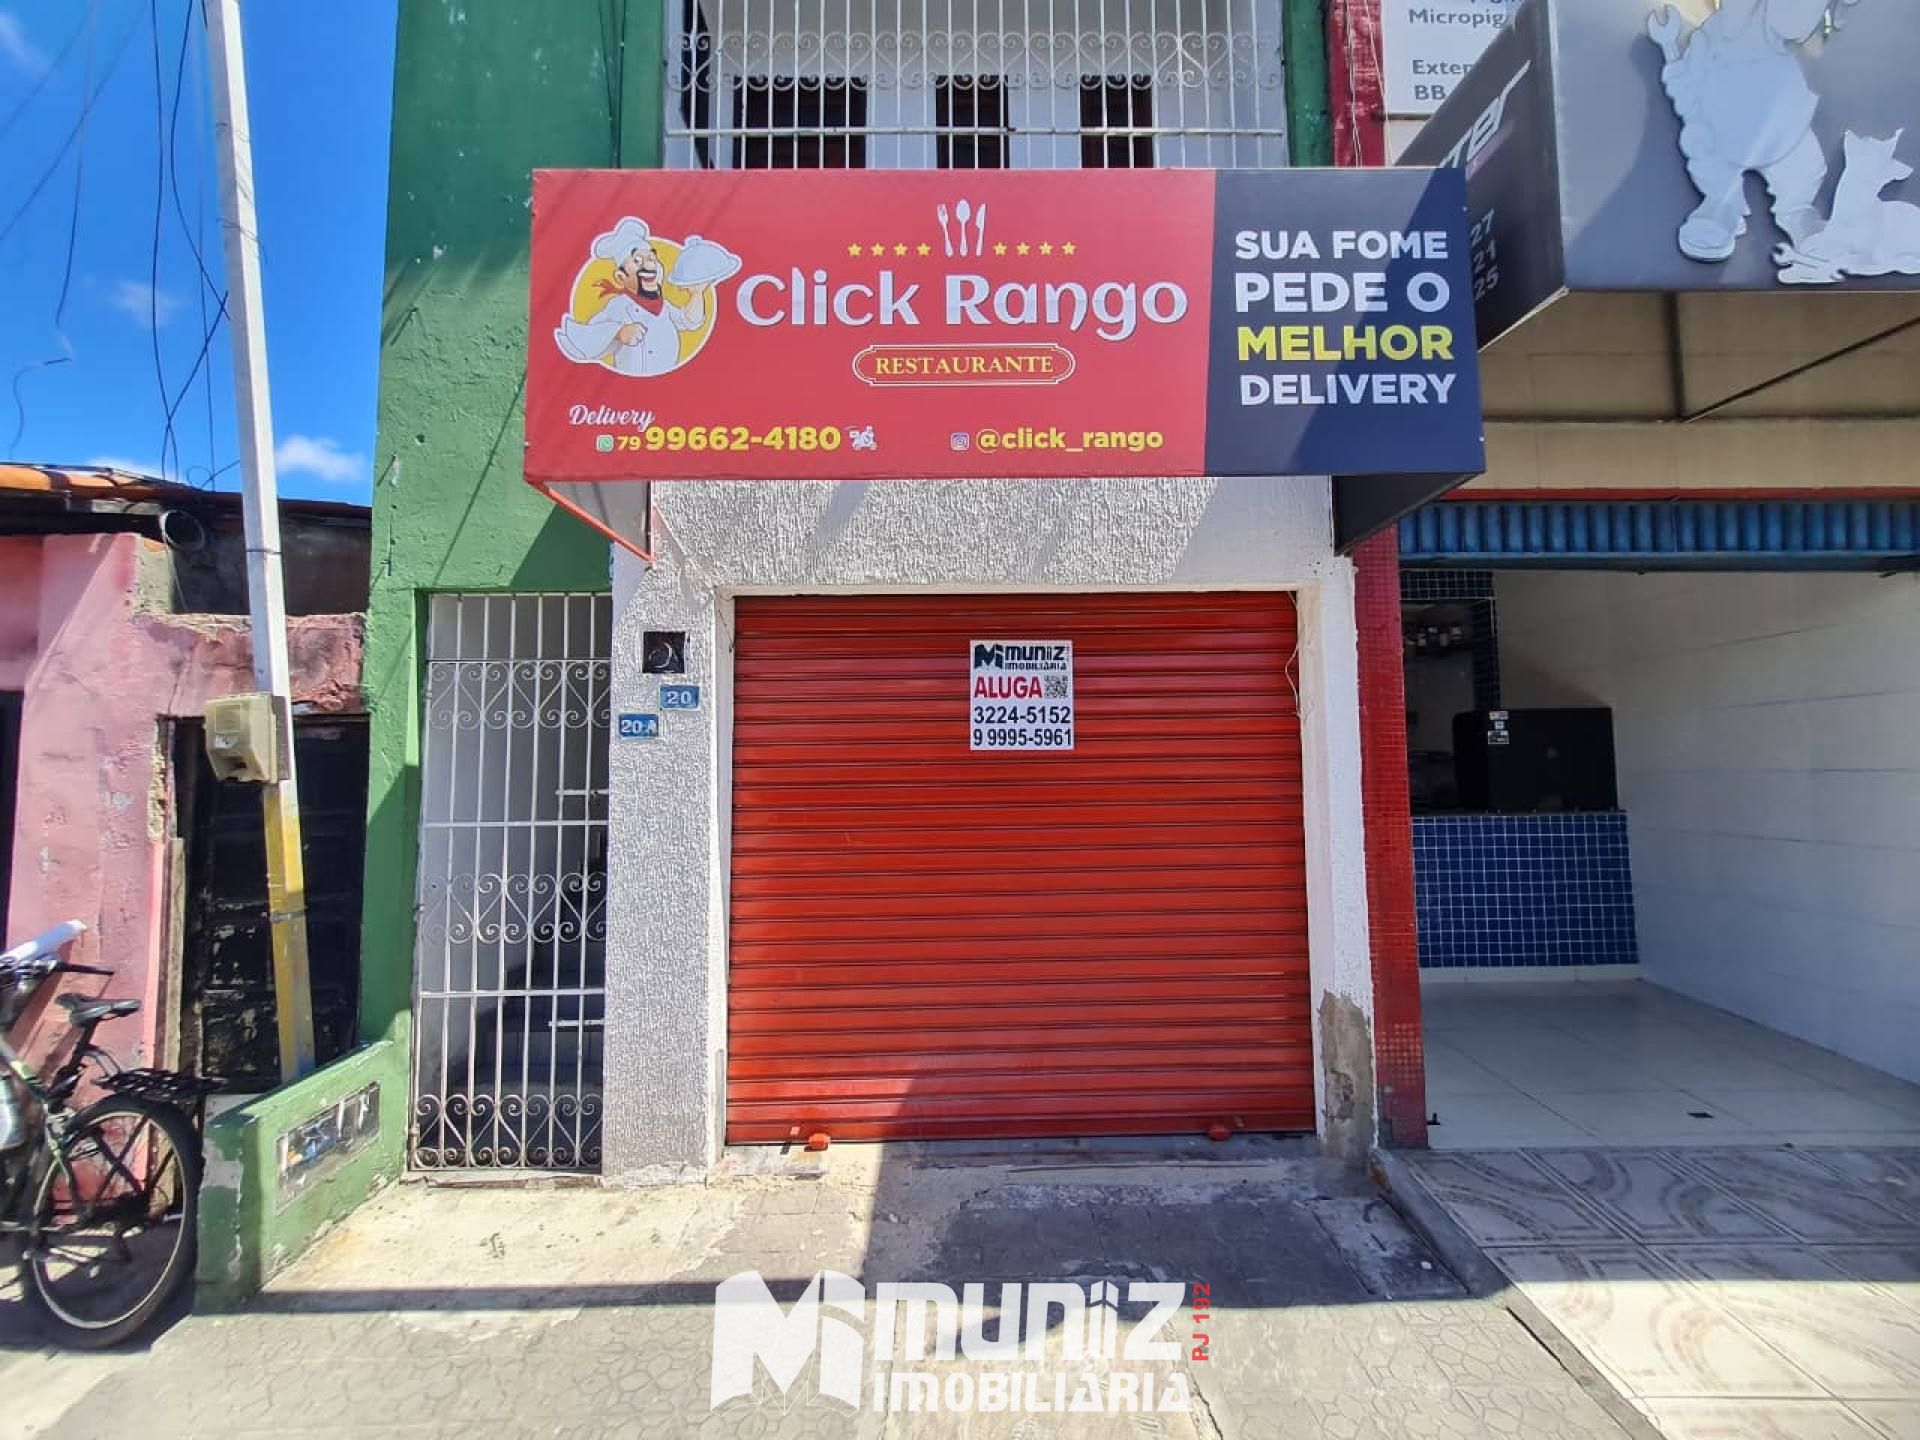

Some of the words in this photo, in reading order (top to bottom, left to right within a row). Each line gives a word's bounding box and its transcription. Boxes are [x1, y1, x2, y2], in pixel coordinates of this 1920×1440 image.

[1235, 230, 1321, 260] SUA
[1332, 230, 1449, 259] FOME
[735, 266, 921, 327] Click
[944, 273, 1189, 342] Rango
[1235, 272, 1388, 313] PEDE
[1406, 272, 1450, 313] O
[1237, 325, 1454, 361] MELHOR
[875, 355, 1054, 375] RESTAURANTE
[1240, 374, 1456, 405] DELIVERY
[569, 404, 655, 432] Delivery
[617, 435, 642, 450] 79
[645, 426, 842, 451] 99662-4180
[976, 428, 1163, 454] @click_rango
[667, 691, 692, 705] 20
[974, 676, 1043, 698] ALUGA
[974, 705, 1071, 724] 3224-5152
[973, 728, 983, 746] 9
[987, 728, 1071, 746] 9995-5961
